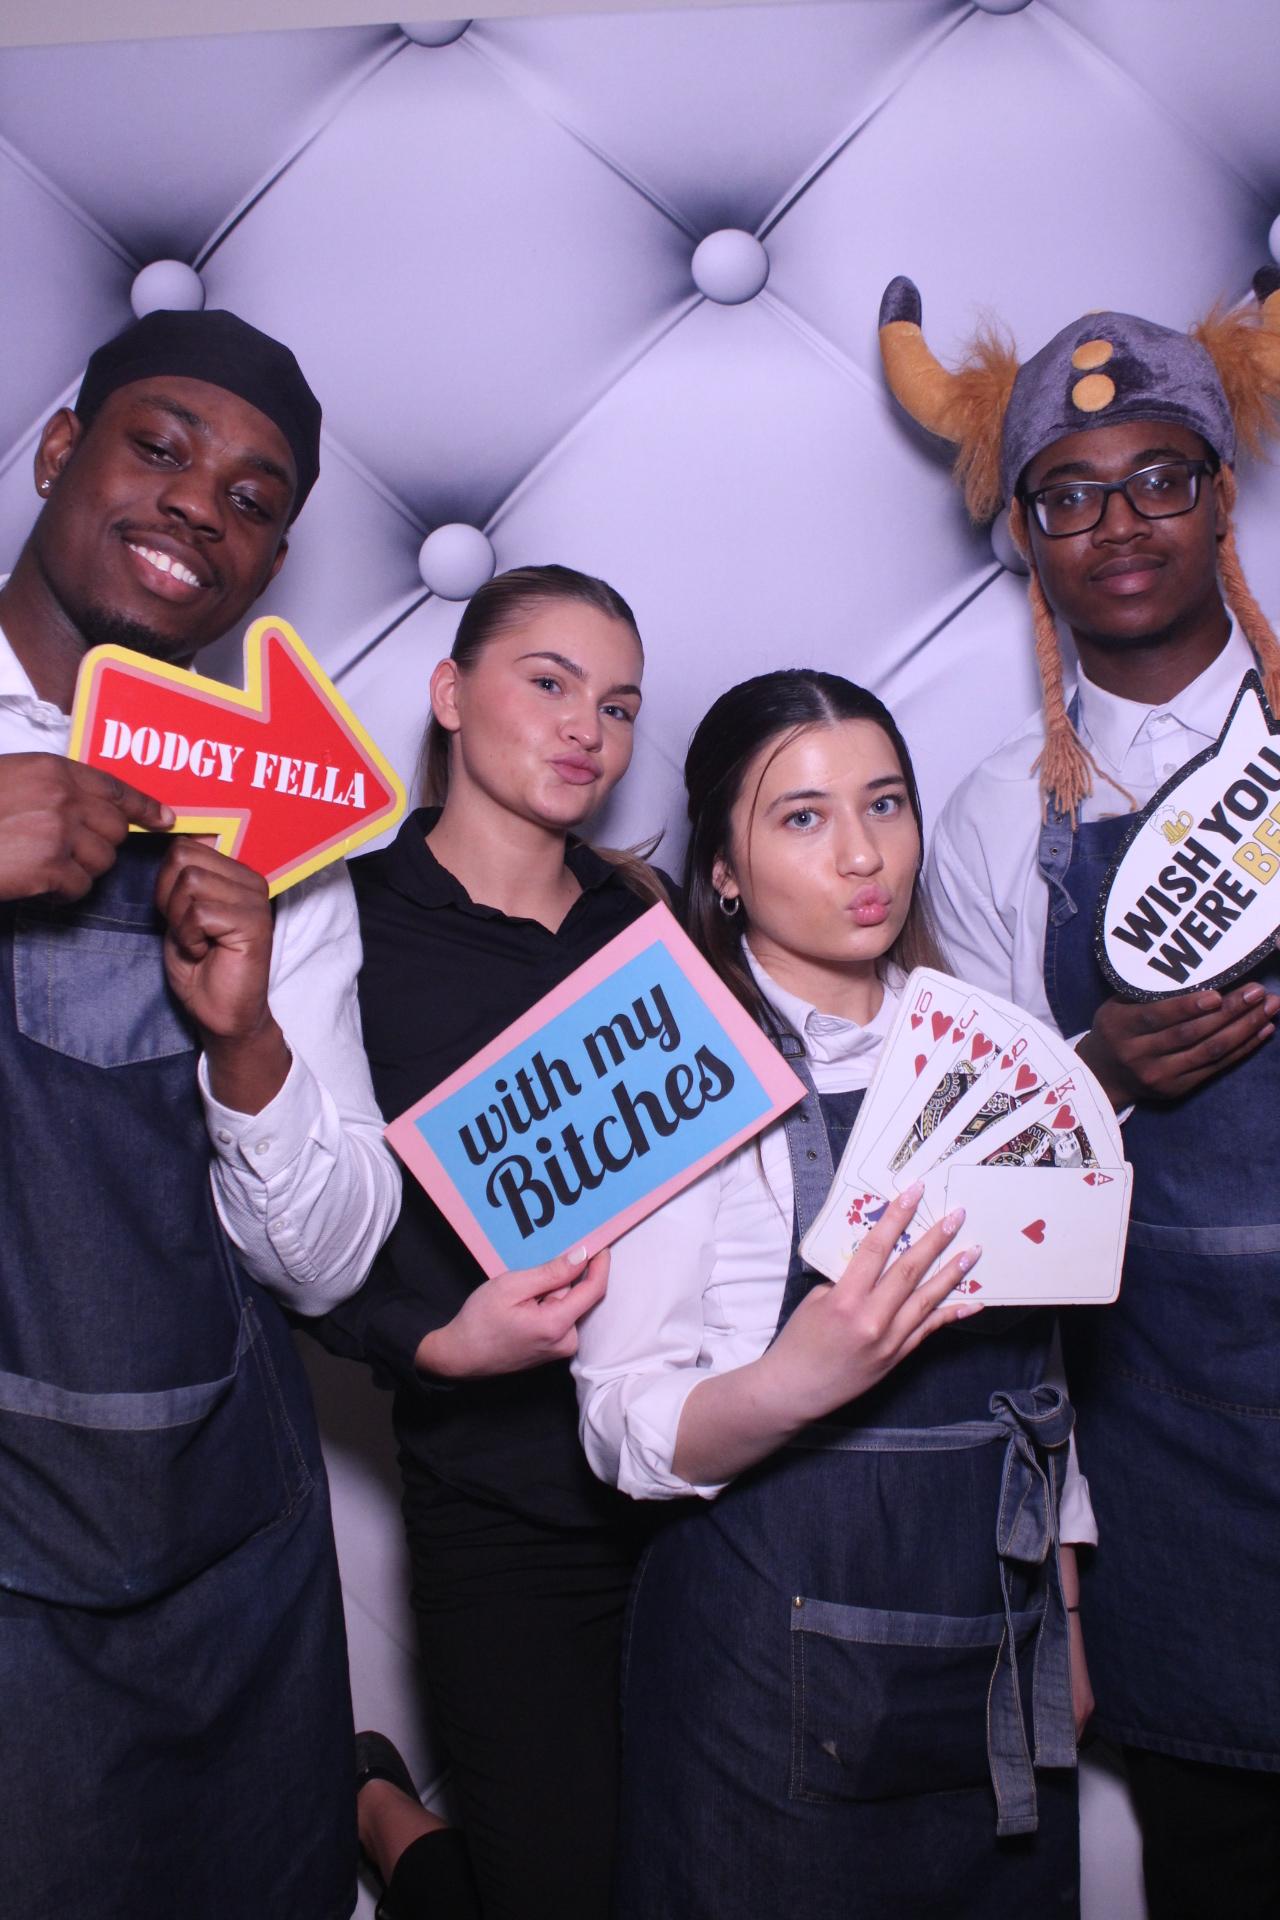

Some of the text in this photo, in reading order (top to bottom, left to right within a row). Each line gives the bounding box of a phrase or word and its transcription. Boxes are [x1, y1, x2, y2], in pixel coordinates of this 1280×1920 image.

[98, 718, 366, 809] DODGY FELLA
[1111, 746, 1280, 953] WISH YOU
[1147, 801, 1280, 985] WERE BE
[914, 988, 933, 1013] 10
[959, 1009, 979, 1030] J
[457, 983, 681, 1166] with my
[1011, 1038, 1028, 1061] Q
[1055, 1077, 1076, 1100] K
[485, 1044, 735, 1240] Bitches
[1097, 1172, 1114, 1186] A
